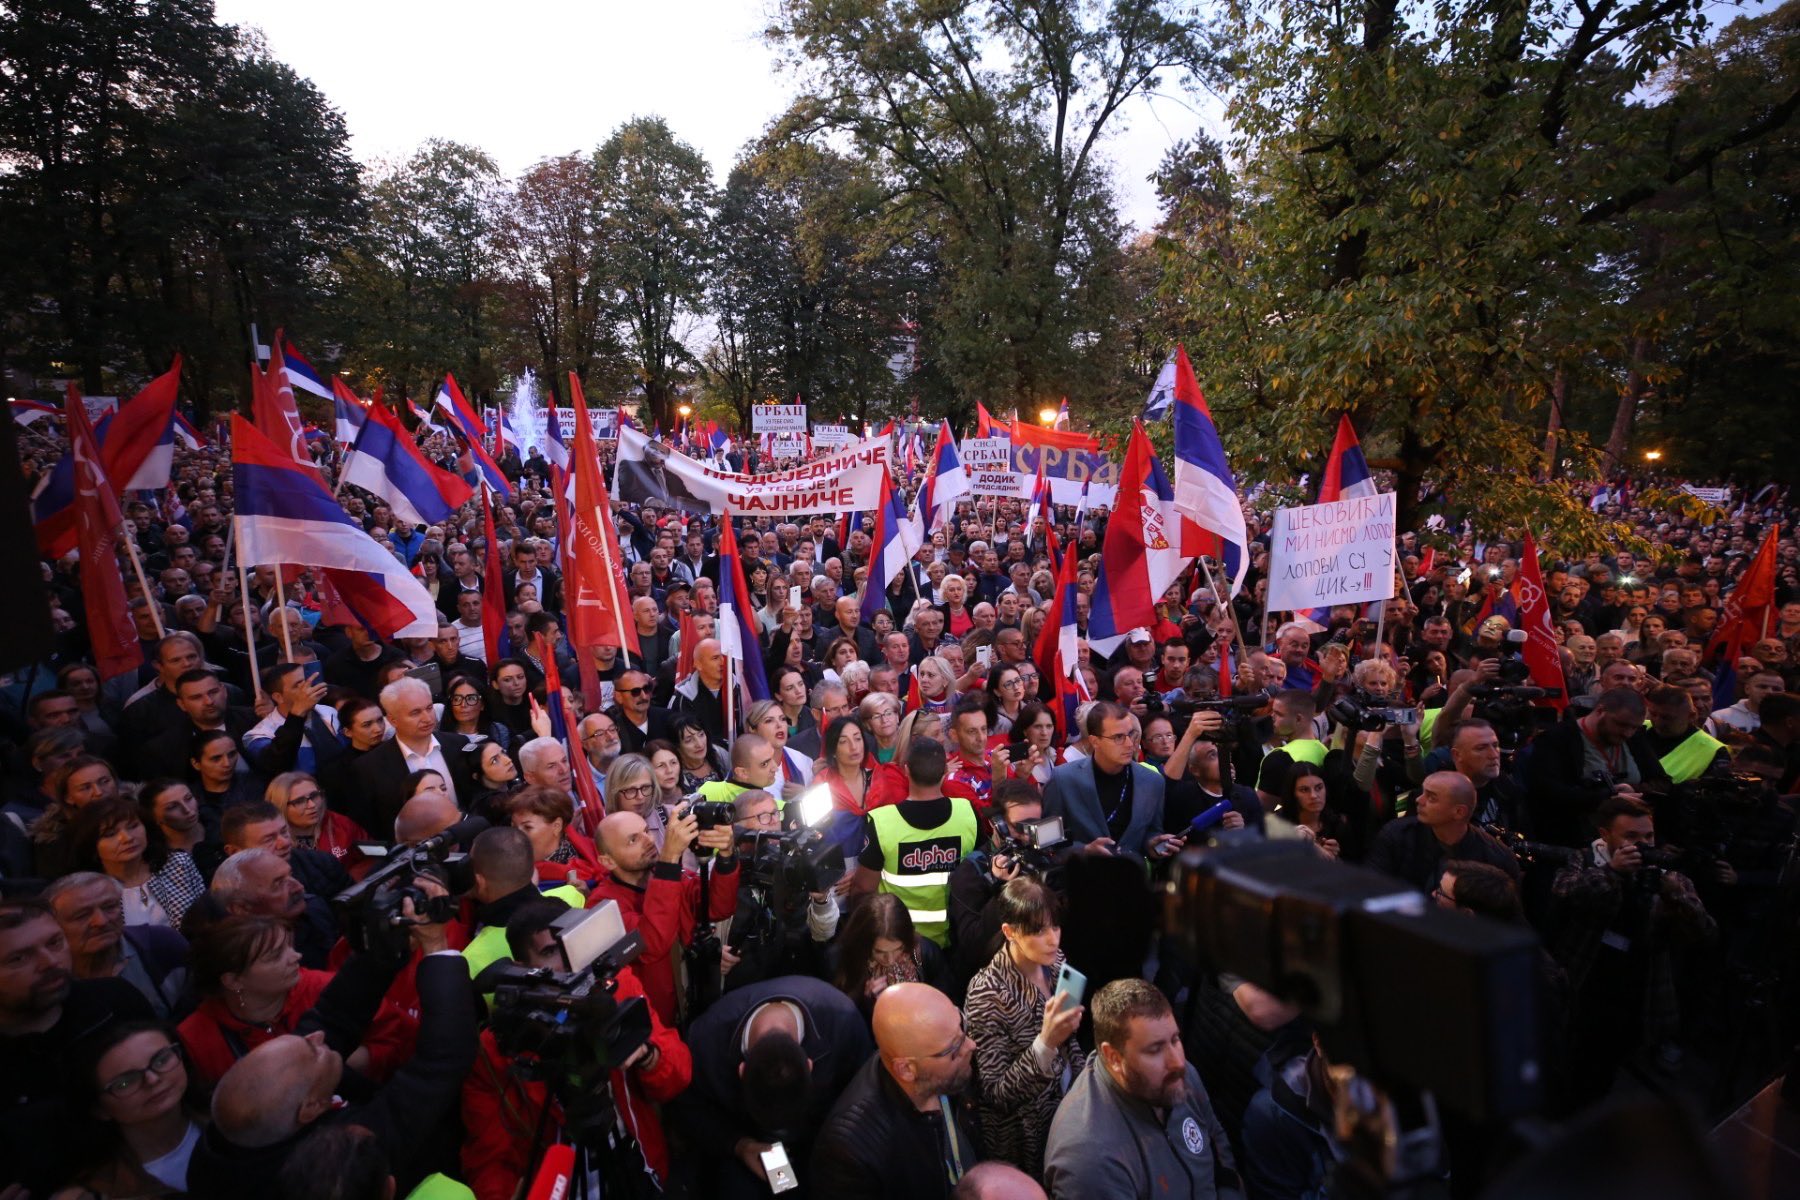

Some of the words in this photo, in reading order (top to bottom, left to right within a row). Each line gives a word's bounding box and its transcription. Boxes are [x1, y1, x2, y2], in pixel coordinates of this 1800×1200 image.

[755, 406, 803, 416] СРБАЦ
[964, 448, 1008, 461] СРБАЦ
[767, 484, 804, 493] ТЕБЕ
[808, 480, 826, 491] ЈЕ
[830, 477, 839, 487] И
[979, 474, 1016, 484] ДОДИК
[727, 487, 855, 511] ЧАЈНИЧЕ
[1288, 495, 1393, 531] ШЕКОВИЋИ
[1285, 534, 1309, 553] МИ
[1315, 526, 1357, 549] НИСМО
[1282, 554, 1340, 580] ЛОПОВИ
[1348, 551, 1366, 570] СУ
[902, 844, 957, 871] alpha
